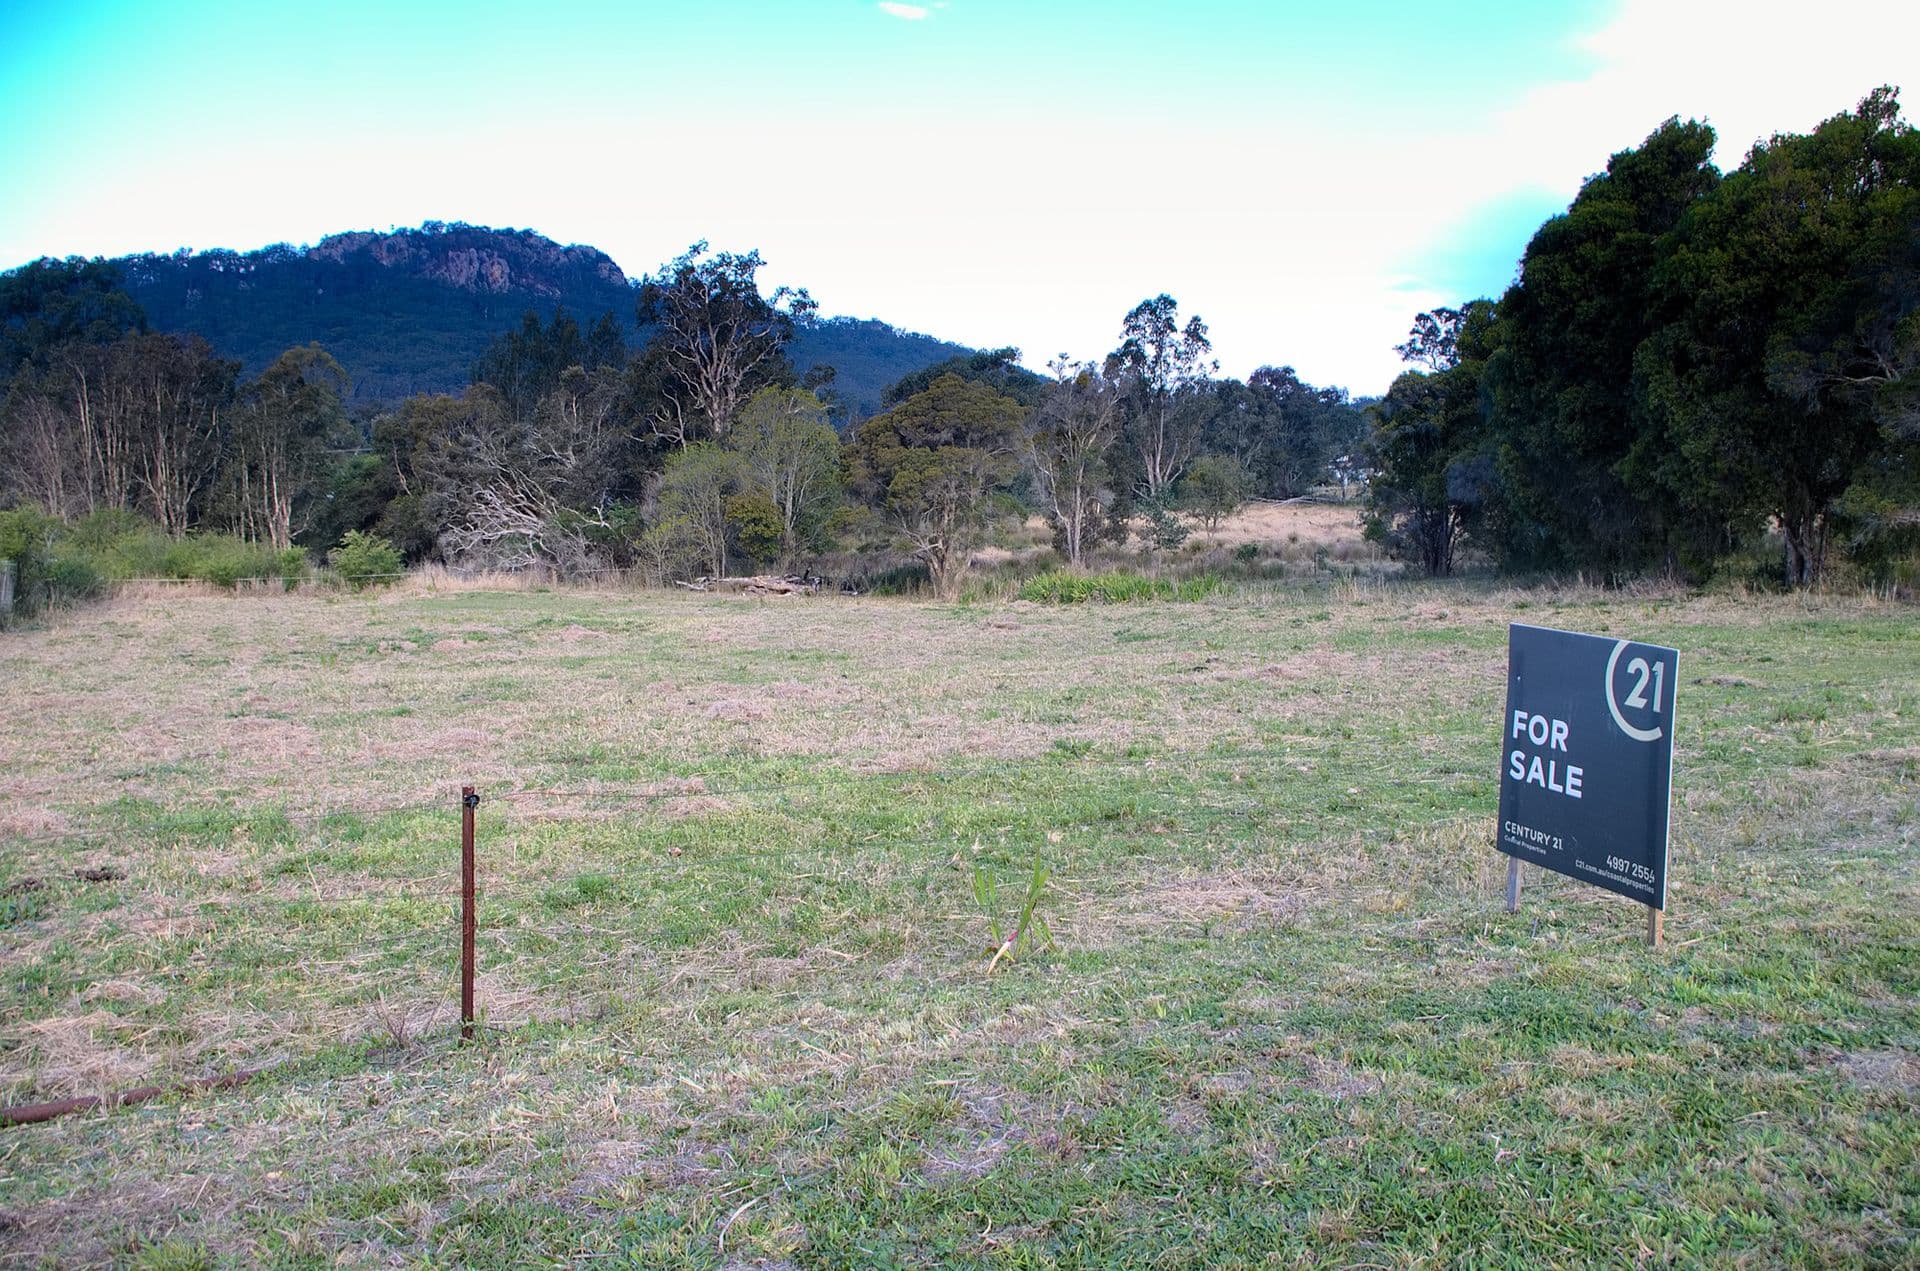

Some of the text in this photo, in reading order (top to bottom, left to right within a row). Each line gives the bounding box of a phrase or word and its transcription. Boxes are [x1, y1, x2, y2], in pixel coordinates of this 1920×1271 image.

[1512, 709, 1569, 752] FOR
[1509, 750, 1584, 799] SALE
[1505, 821, 1563, 850] CENTURY 21
[1521, 841, 1547, 855] Properties
[1606, 855, 1655, 883] 4997 2554
